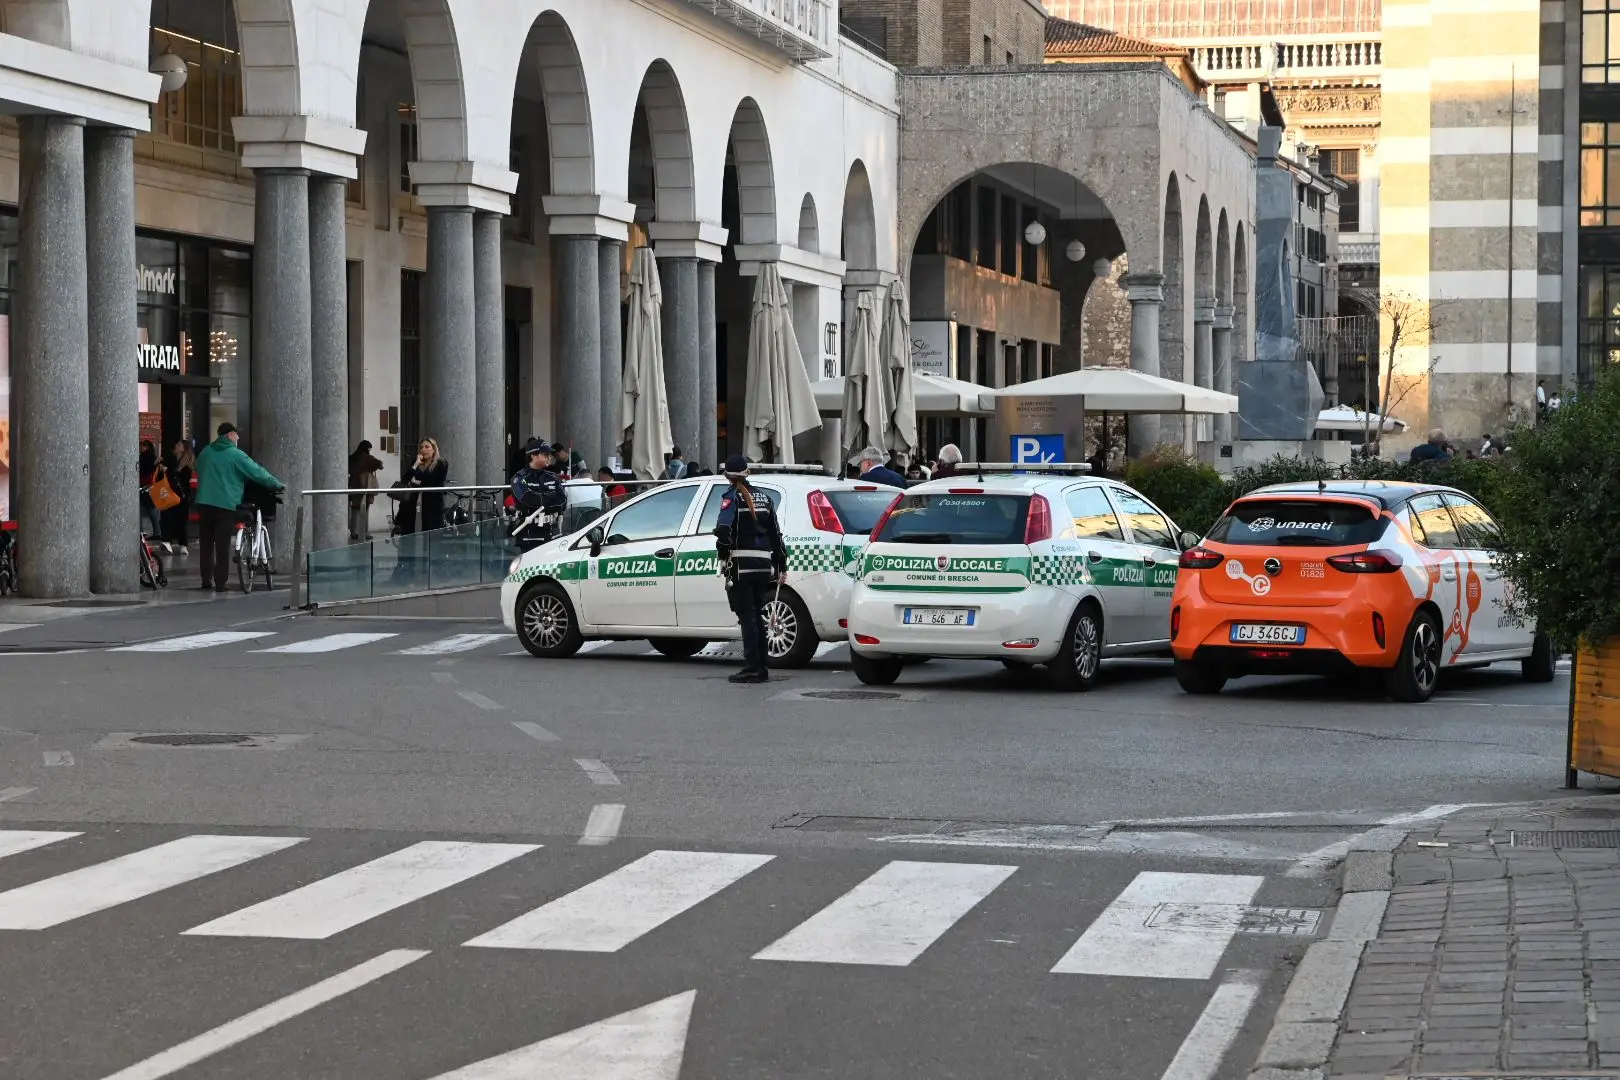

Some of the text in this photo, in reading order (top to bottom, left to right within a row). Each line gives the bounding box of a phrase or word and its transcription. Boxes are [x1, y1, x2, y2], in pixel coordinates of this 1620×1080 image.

[1018, 438, 1040, 464] P
[1276, 521, 1333, 531] unareti
[606, 560, 657, 575] POLIZIA
[887, 558, 1003, 571] POLIZIA LOCALE
[1113, 567, 1144, 583] POLIZIA
[606, 580, 628, 588] COMUNE
[914, 614, 923, 623] YA
[954, 615, 963, 625] AF
[1239, 626, 1254, 639] GJ
